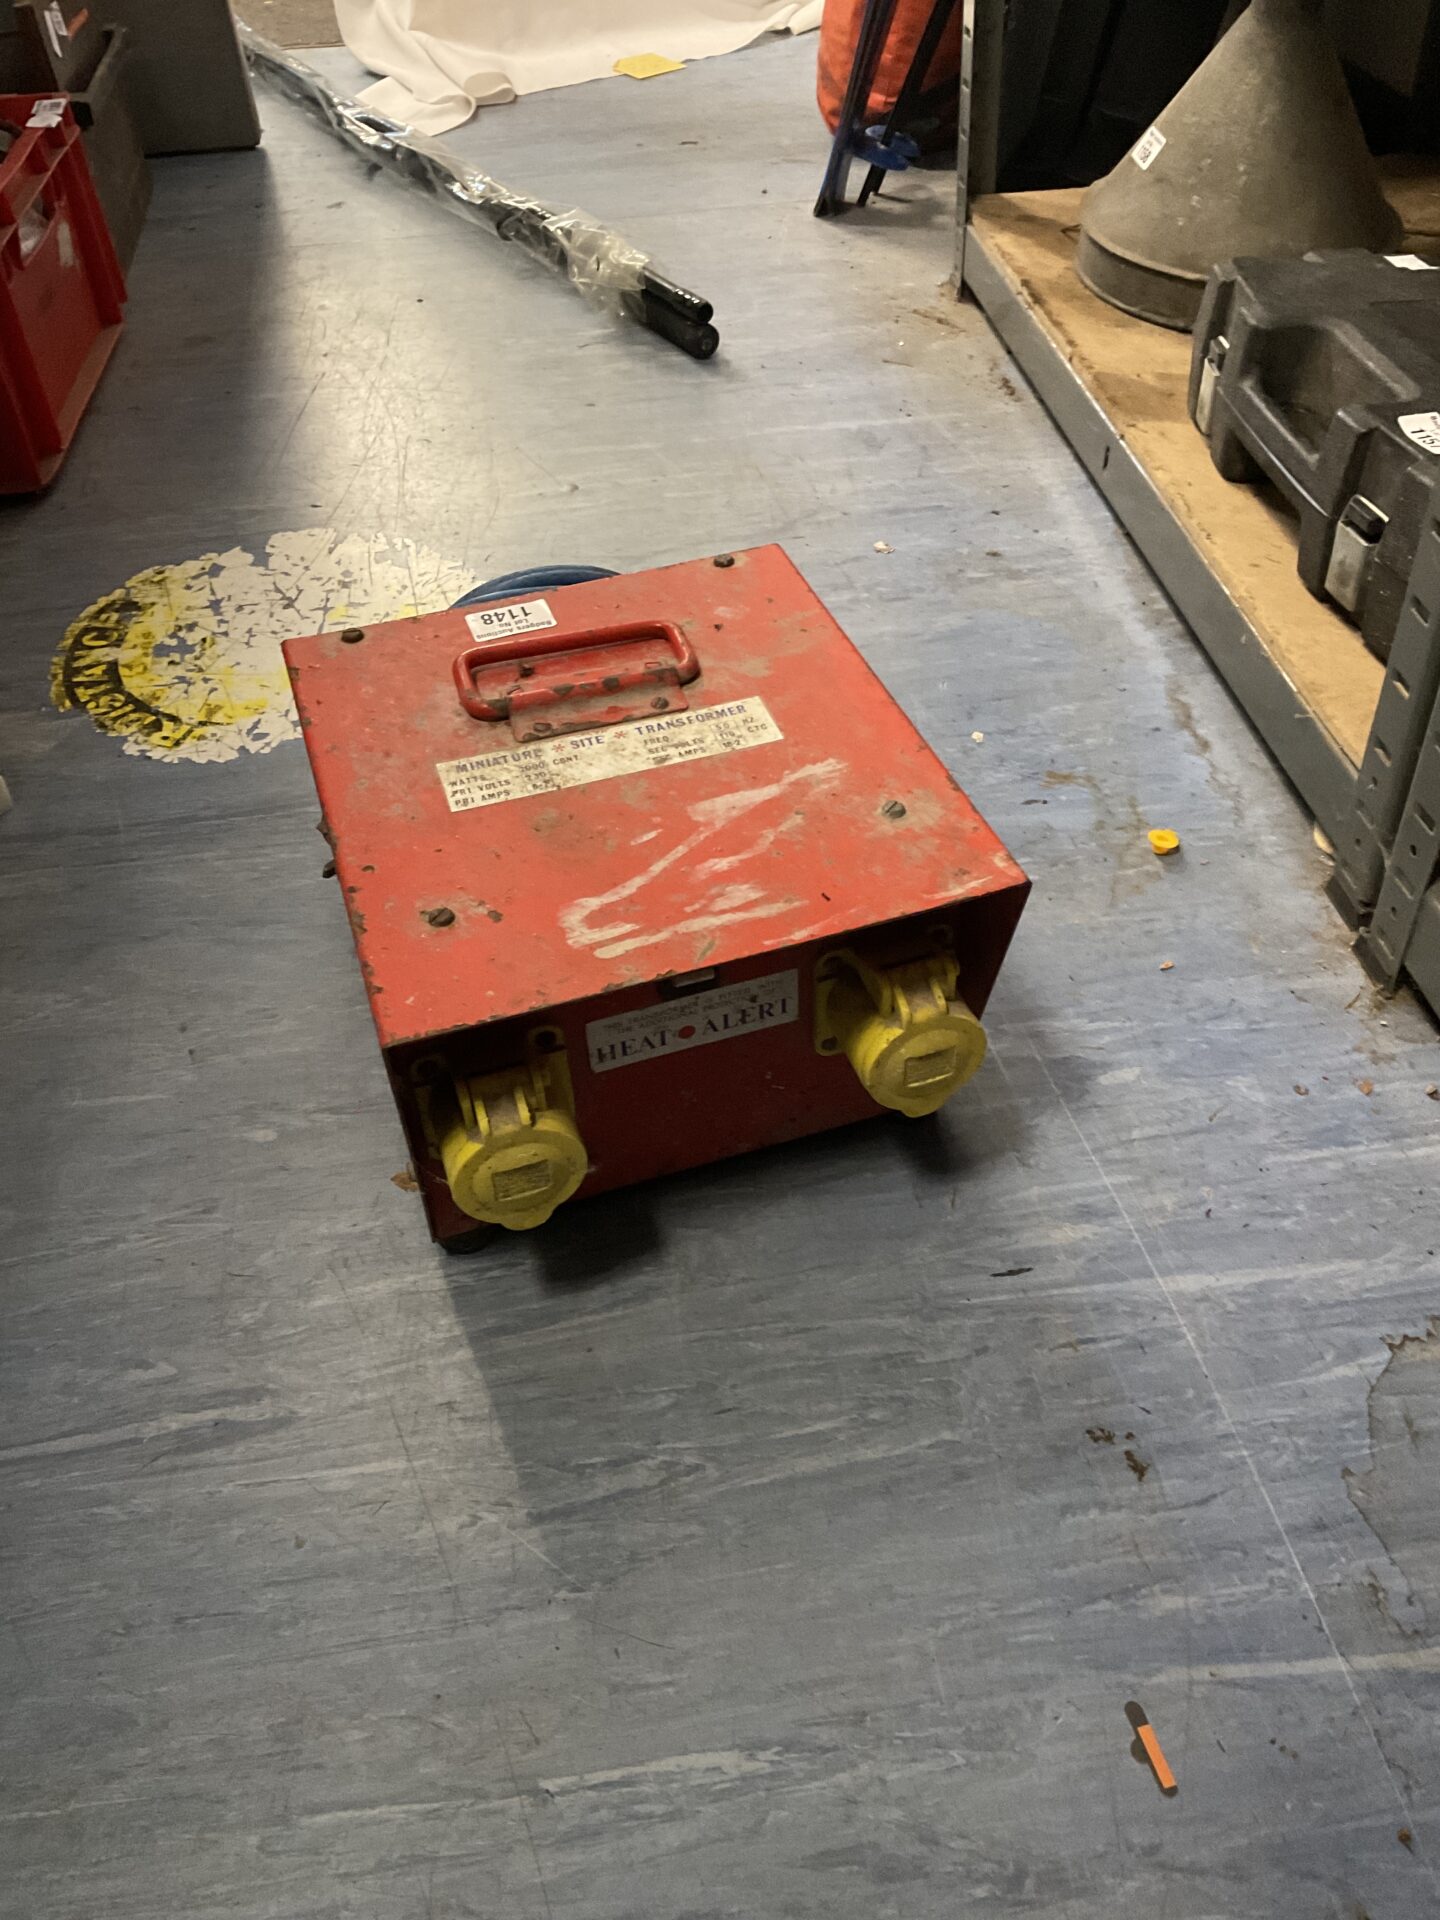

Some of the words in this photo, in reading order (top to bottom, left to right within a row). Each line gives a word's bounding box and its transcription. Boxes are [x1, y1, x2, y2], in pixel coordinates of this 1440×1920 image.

[480, 605, 532, 626] 1148
[514, 618, 529, 626] Lot
[516, 620, 552, 631] Badgers
[476, 627, 513, 640] Auctions
[456, 748, 544, 774] MINIATURE
[569, 735, 606, 750] SITE
[634, 704, 748, 736] TRANSFORMER
[677, 747, 707, 758] AMPS
[478, 779, 512, 792] VOLTS
[480, 789, 511, 802] AMPS
[595, 1029, 672, 1064] HEAT
[702, 997, 793, 1033] ALERT
